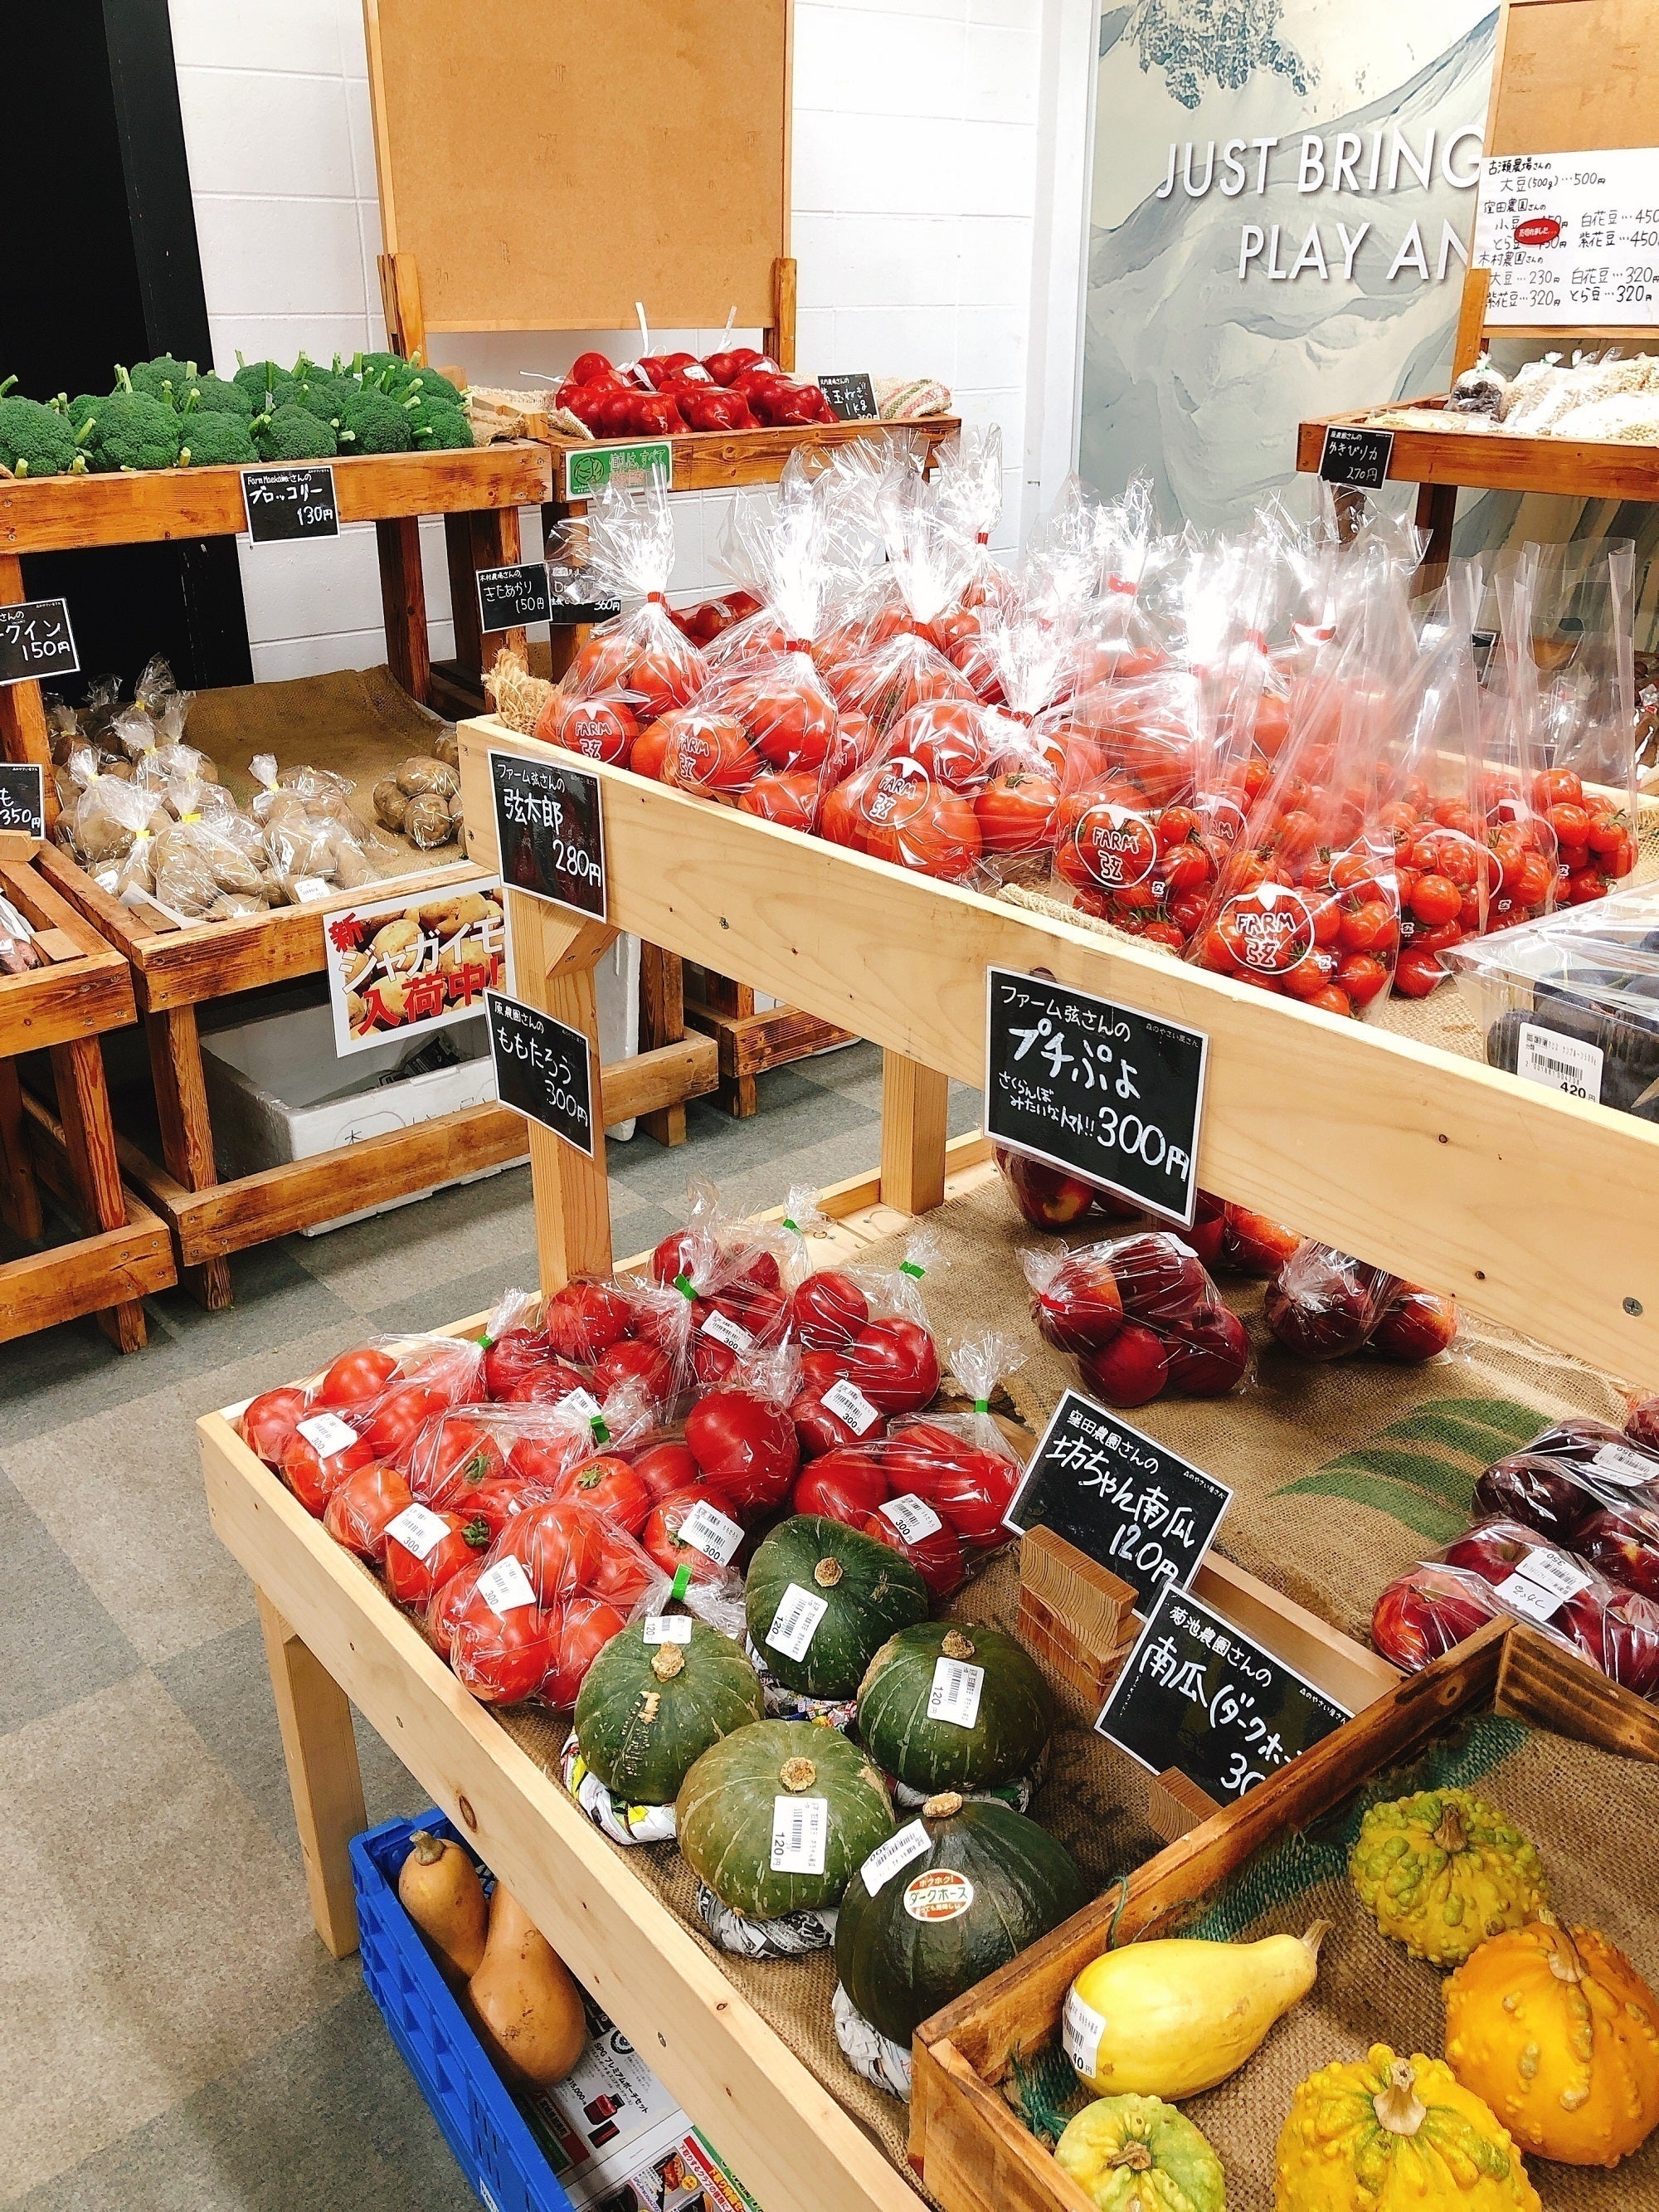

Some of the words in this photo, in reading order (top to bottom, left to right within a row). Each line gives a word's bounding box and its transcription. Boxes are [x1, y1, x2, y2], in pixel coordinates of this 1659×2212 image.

[1156, 137, 1277, 197] JUST
[1297, 124, 1485, 192] BRING
[1238, 220, 1371, 280] PLAY
[1346, 466, 1377, 481] 270円
[249, 483, 323, 504] ブロッコリー
[297, 506, 333, 526] 130円
[483, 580, 532, 602] きたあかり
[515, 597, 544, 613] 150円
[22, 641, 71, 661] 150円
[575, 721, 612, 737] FARM
[677, 733, 709, 757] FARM
[498, 764, 565, 793] ファーム弦さんの
[878, 773, 917, 800] FARM
[504, 788, 563, 835] 弦太郎
[1092, 826, 1139, 855] FARM
[552, 839, 601, 887] 280円
[328, 913, 364, 953] 新
[1235, 912, 1297, 934] FARM
[338, 916, 505, 995] ジャガイモ
[1000, 985, 1131, 1042] ファーム弦さんの
[497, 1026, 572, 1084] ももたろう
[1008, 1018, 1141, 1100] プチぷよ
[999, 1071, 1055, 1103] さくらんぼ
[544, 1079, 588, 1128] 300円
[1097, 1107, 1190, 1182] 300円
[1066, 1409, 1159, 1474] 窪田農園さんの
[1045, 1435, 1196, 1548] 坊ちゃん南瓜
[1108, 1524, 1180, 1583] 120円
[1512, 1585, 1546, 1609] つがる
[1169, 1605, 1272, 1688] 菊池農園さんの
[908, 1887, 968, 1906] ダークホース
[594, 2042, 607, 2057] SPG
